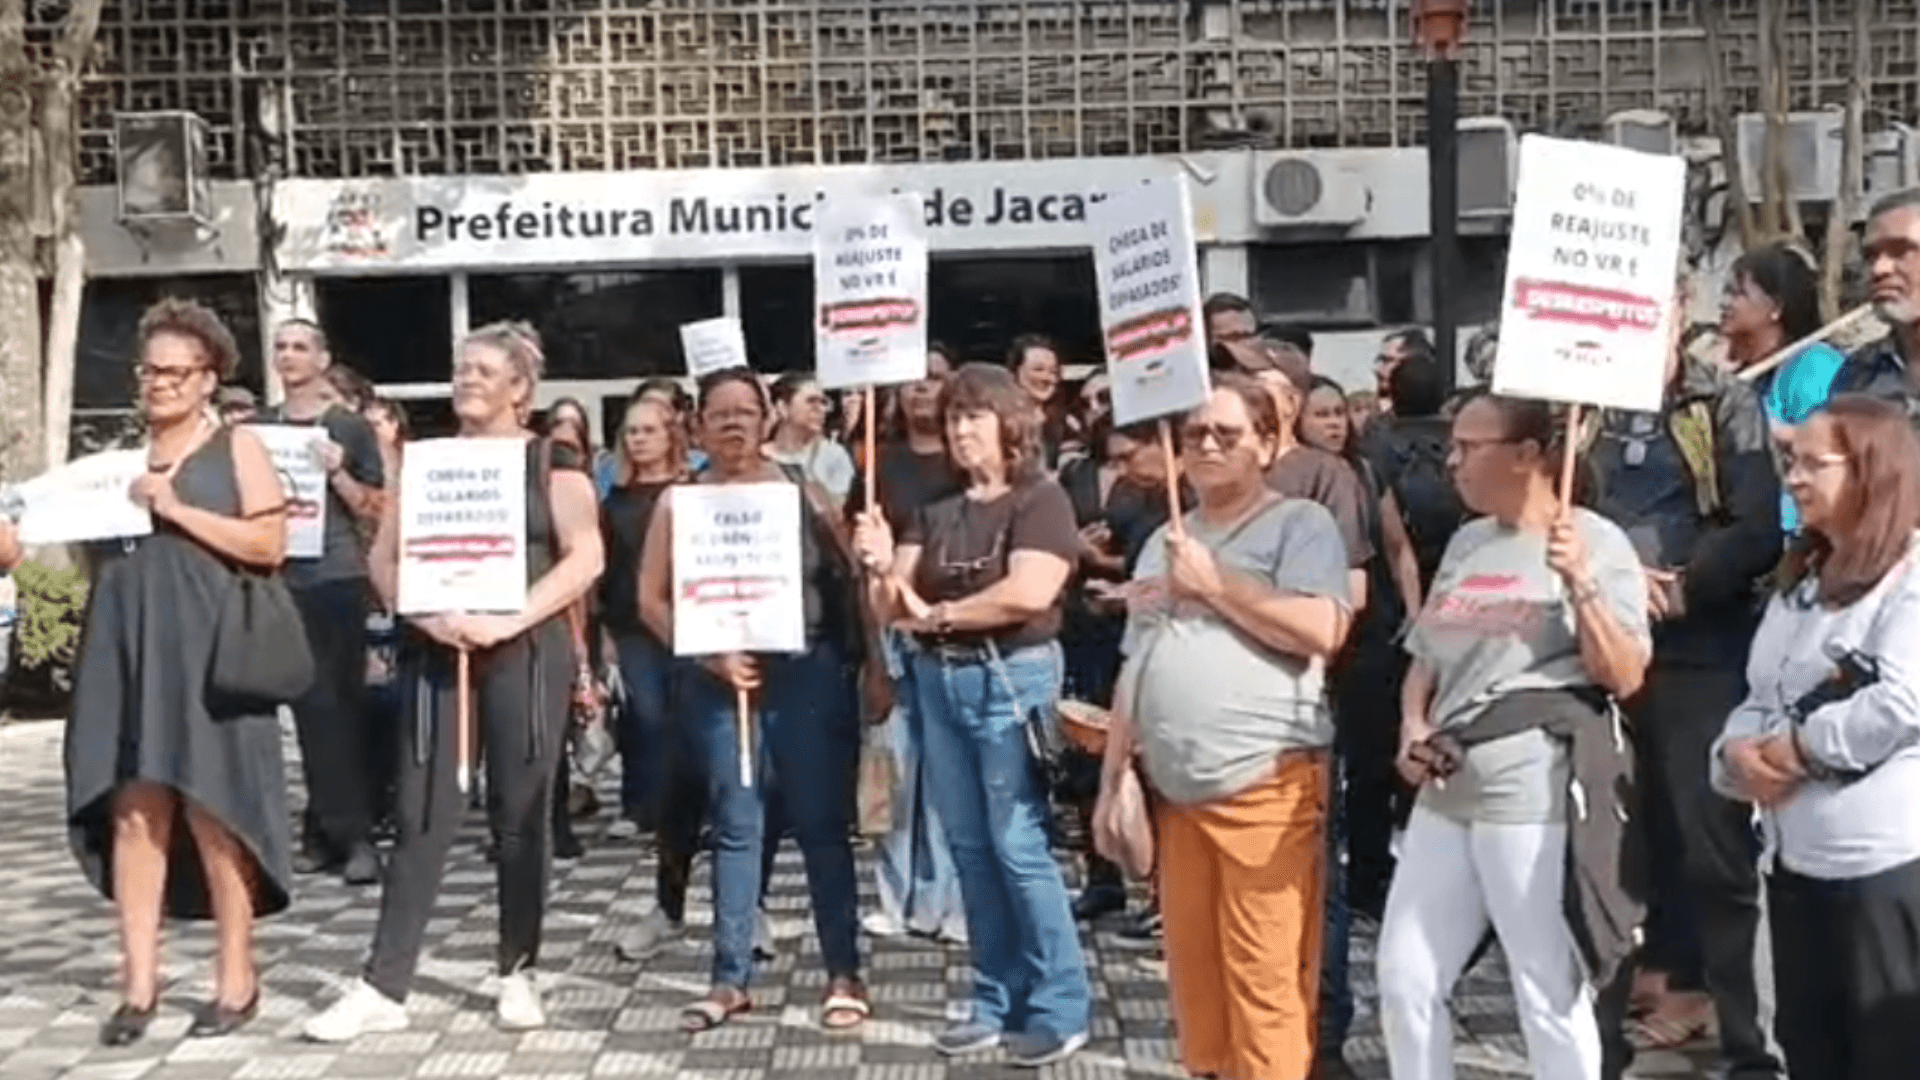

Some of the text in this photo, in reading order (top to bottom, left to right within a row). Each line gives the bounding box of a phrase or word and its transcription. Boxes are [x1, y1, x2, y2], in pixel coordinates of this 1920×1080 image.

[416, 179, 1150, 240] Prefeitura Munic de Jaca
[1612, 188, 1636, 209] DE
[1551, 212, 1650, 246] REAJUSTE
[1553, 247, 1588, 268] NO
[1595, 254, 1622, 273] VR
